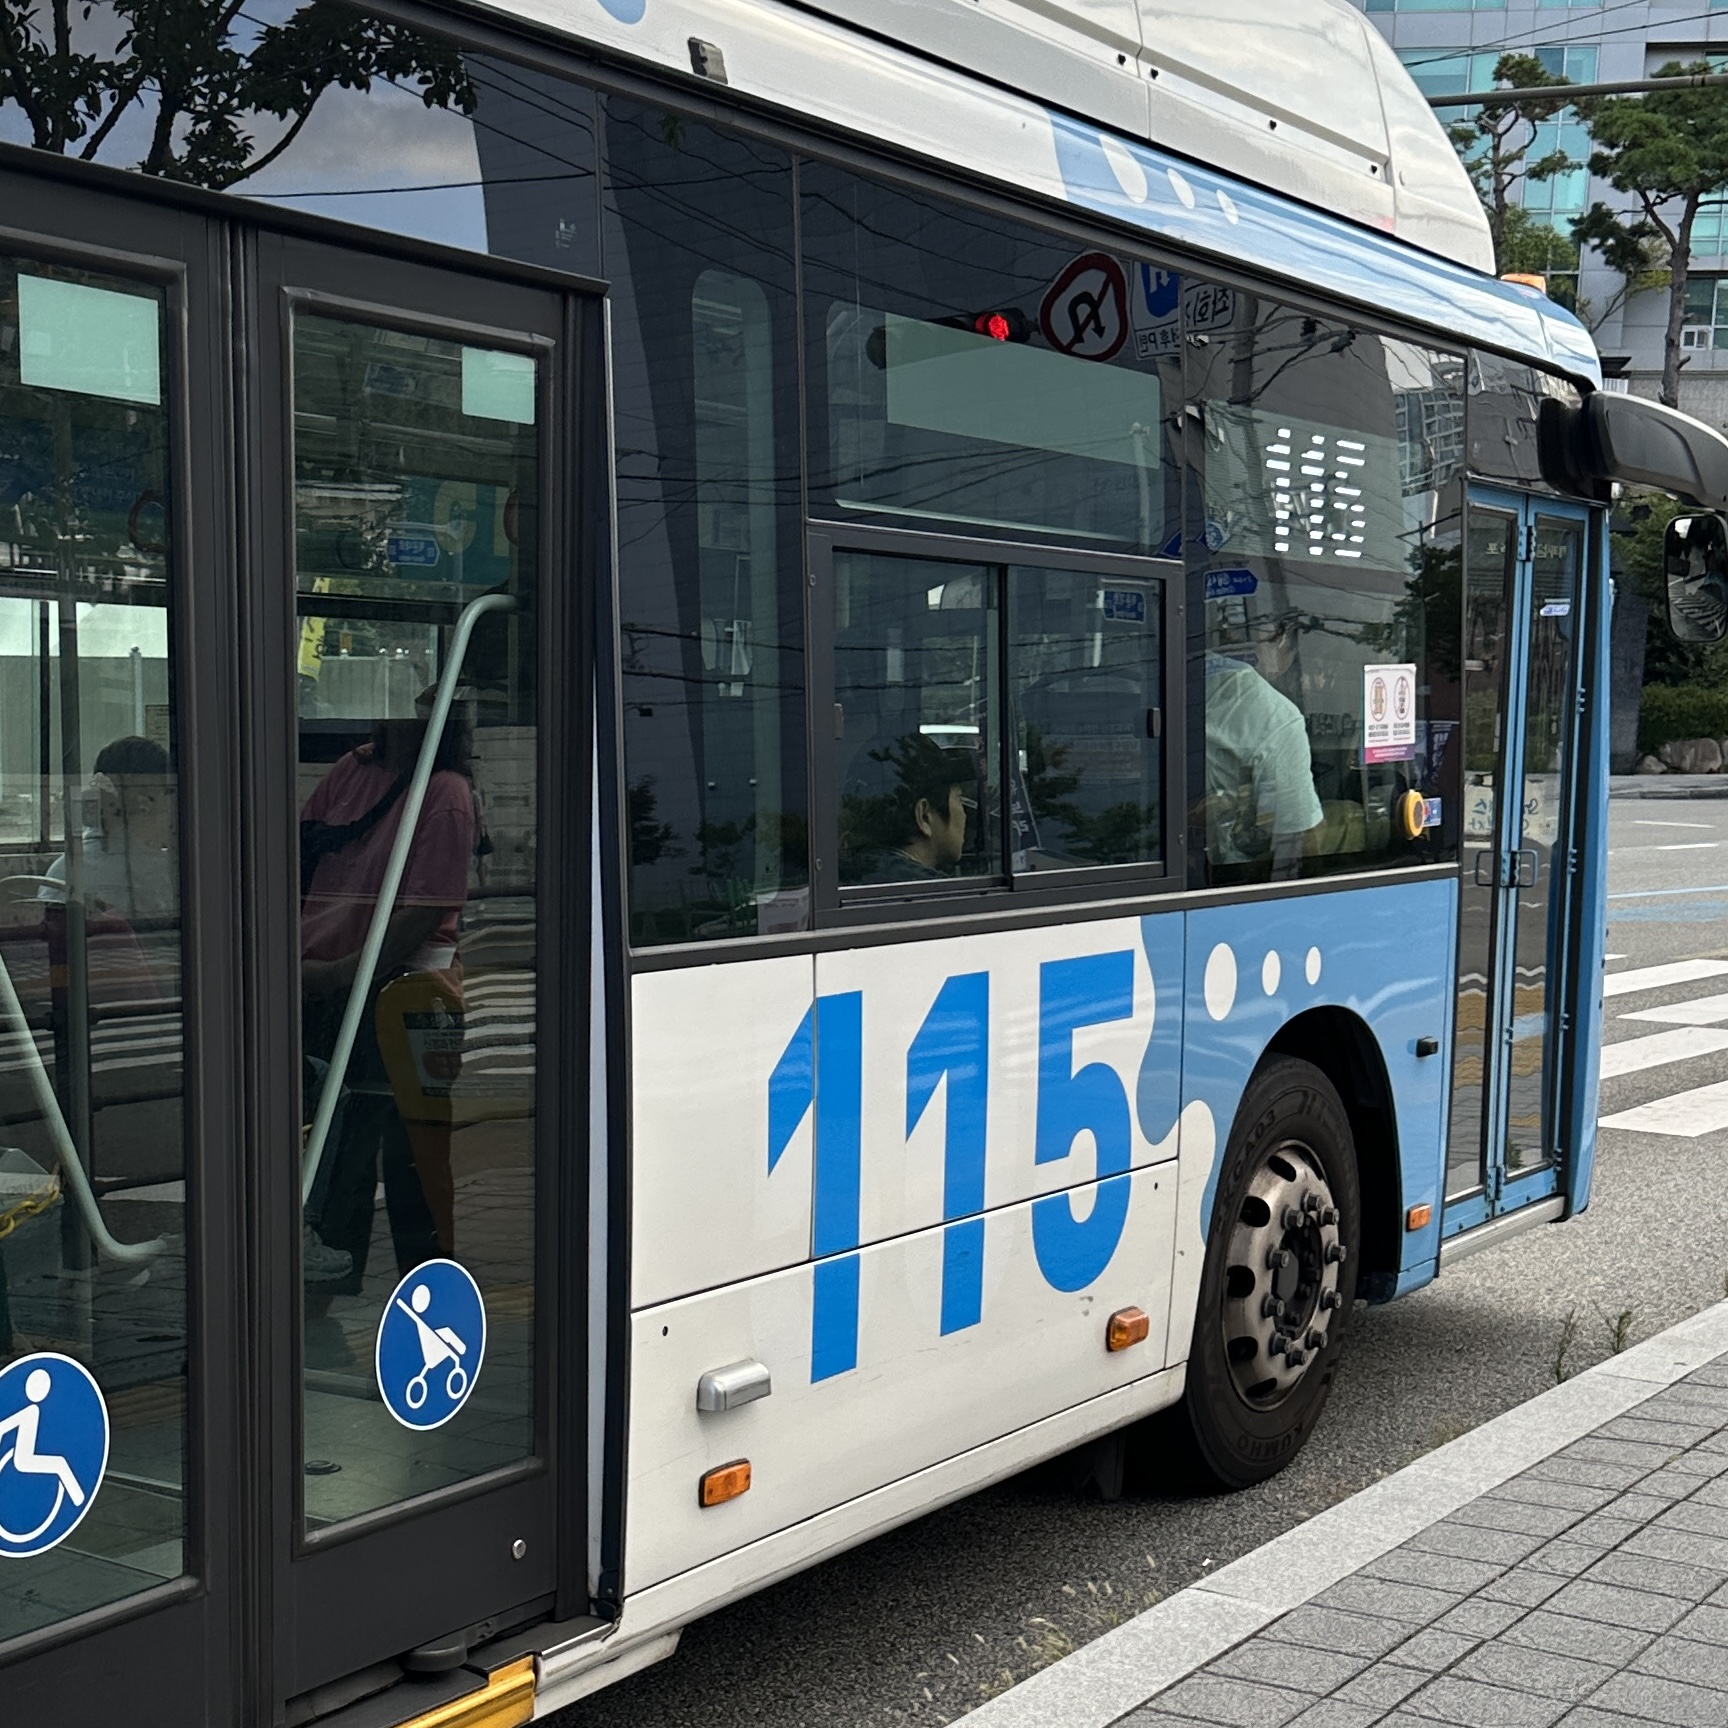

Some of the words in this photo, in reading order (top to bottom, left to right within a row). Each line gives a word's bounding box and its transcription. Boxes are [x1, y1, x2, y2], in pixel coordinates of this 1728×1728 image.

[1266, 428, 1366, 558] 115
[767, 949, 1134, 1382] 115
[1238, 1421, 1304, 1458] KUMHO
